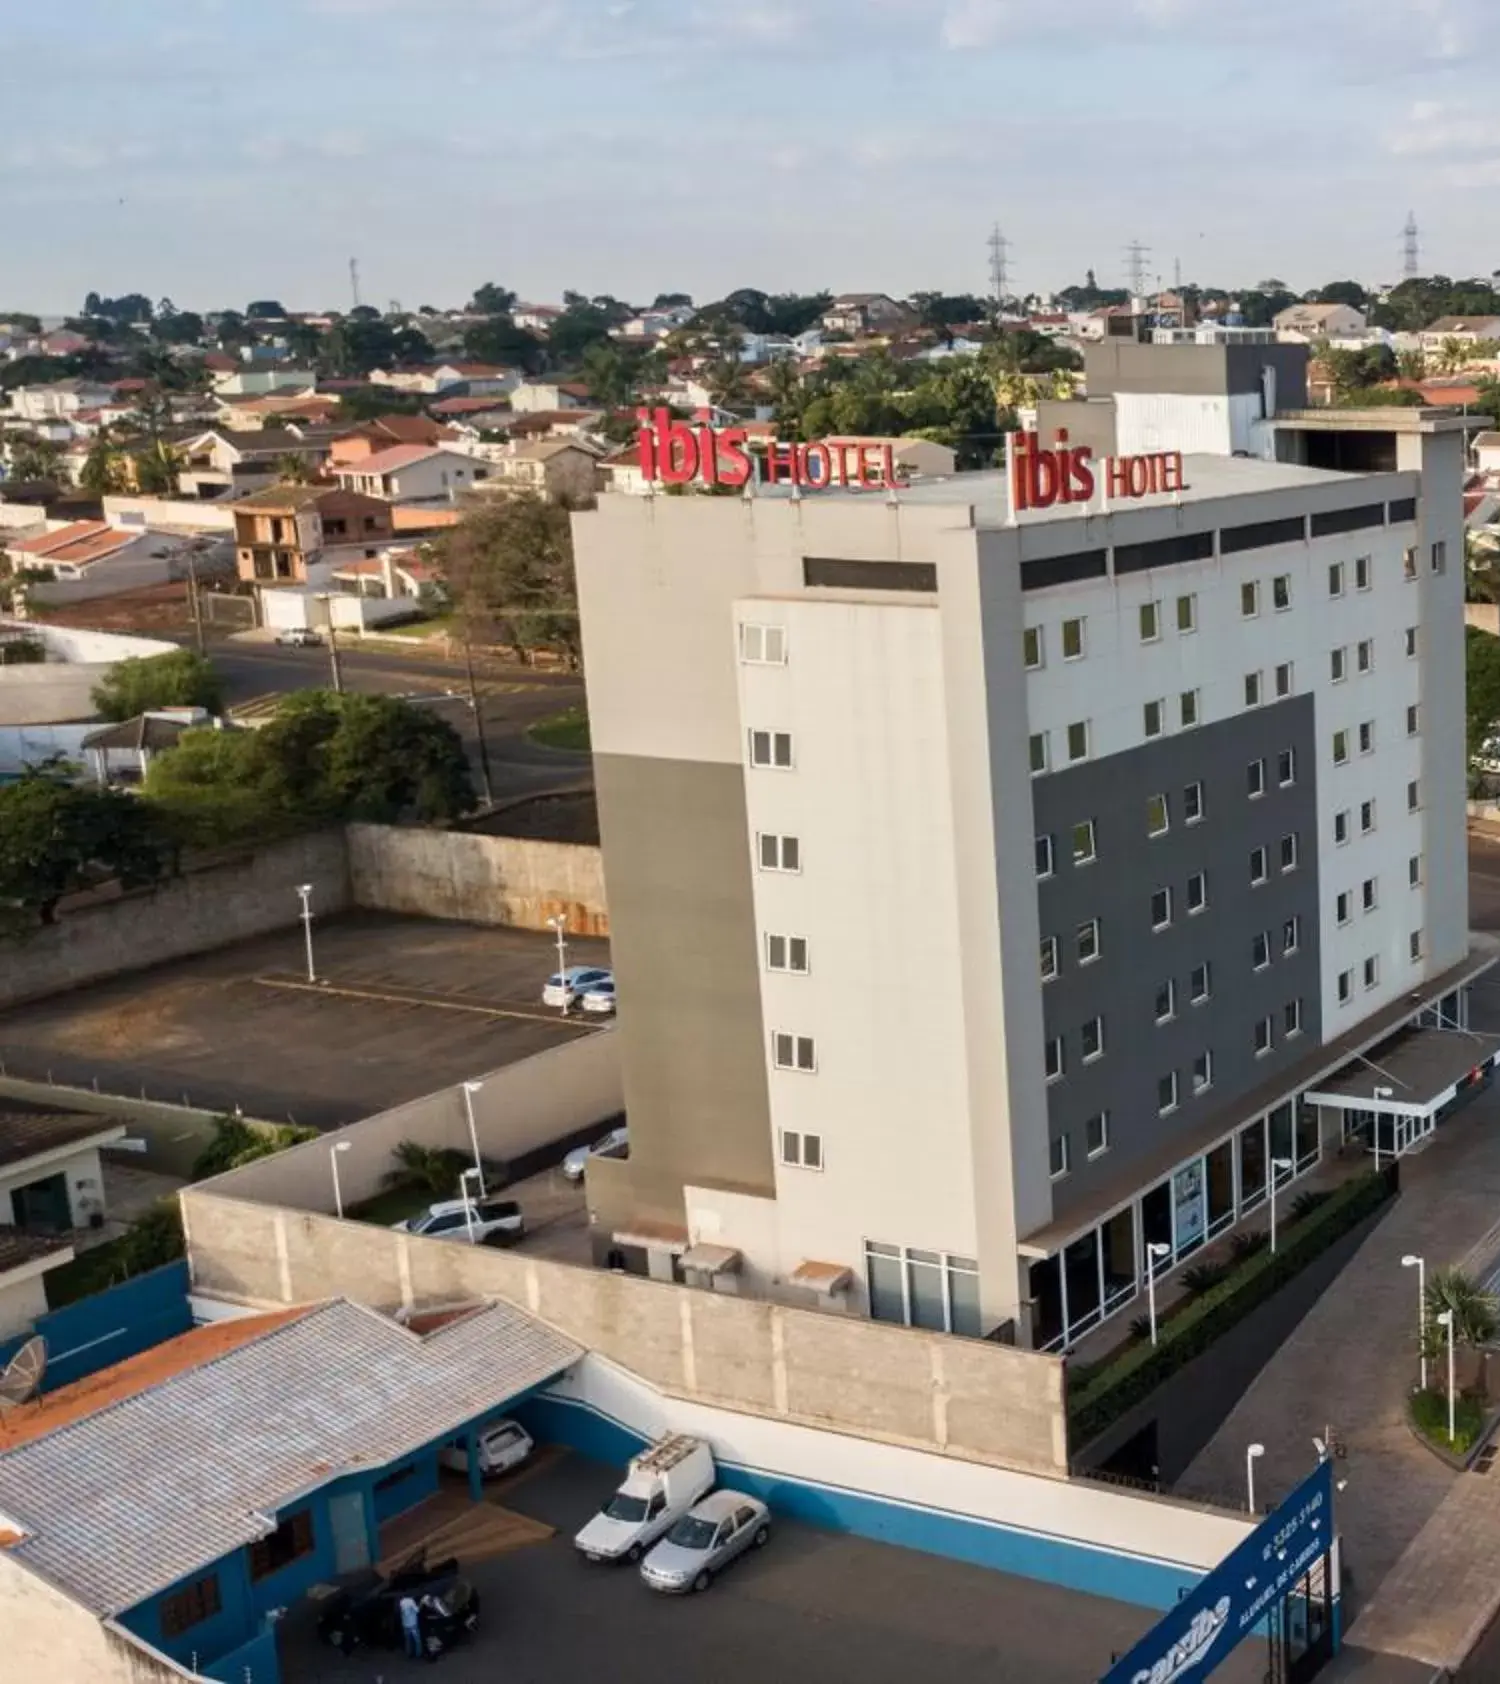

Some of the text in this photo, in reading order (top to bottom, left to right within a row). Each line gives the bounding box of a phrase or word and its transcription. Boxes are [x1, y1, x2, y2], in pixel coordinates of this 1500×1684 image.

[636, 405, 911, 489] ibis HOTEL
[1012, 427, 1191, 511] ibis HOTEL
